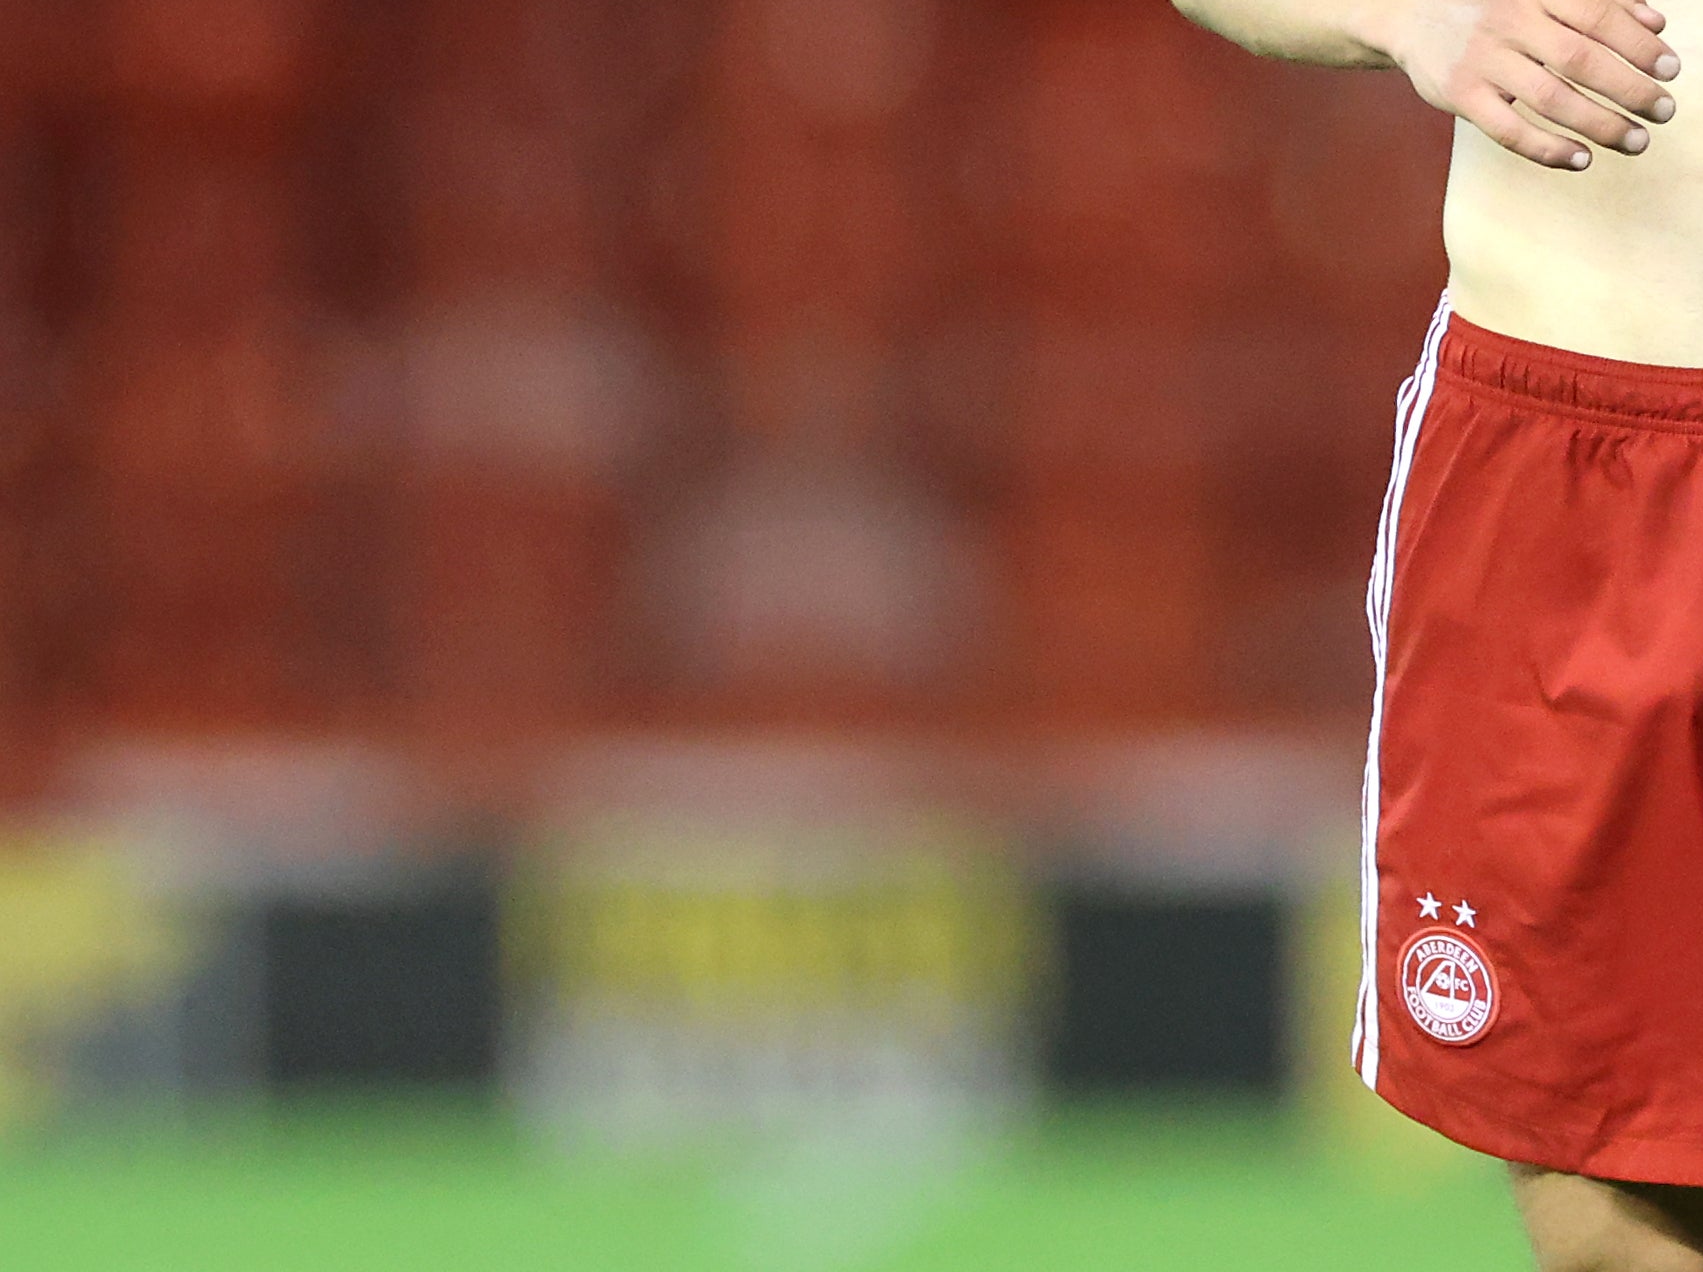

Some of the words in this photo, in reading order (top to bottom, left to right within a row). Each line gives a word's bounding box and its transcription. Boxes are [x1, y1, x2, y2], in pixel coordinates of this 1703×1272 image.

[1416, 941, 1479, 974] ABERDEEN
[1406, 986, 1462, 1037] FOOTBALL
[1462, 999, 1487, 1032] CLUB
